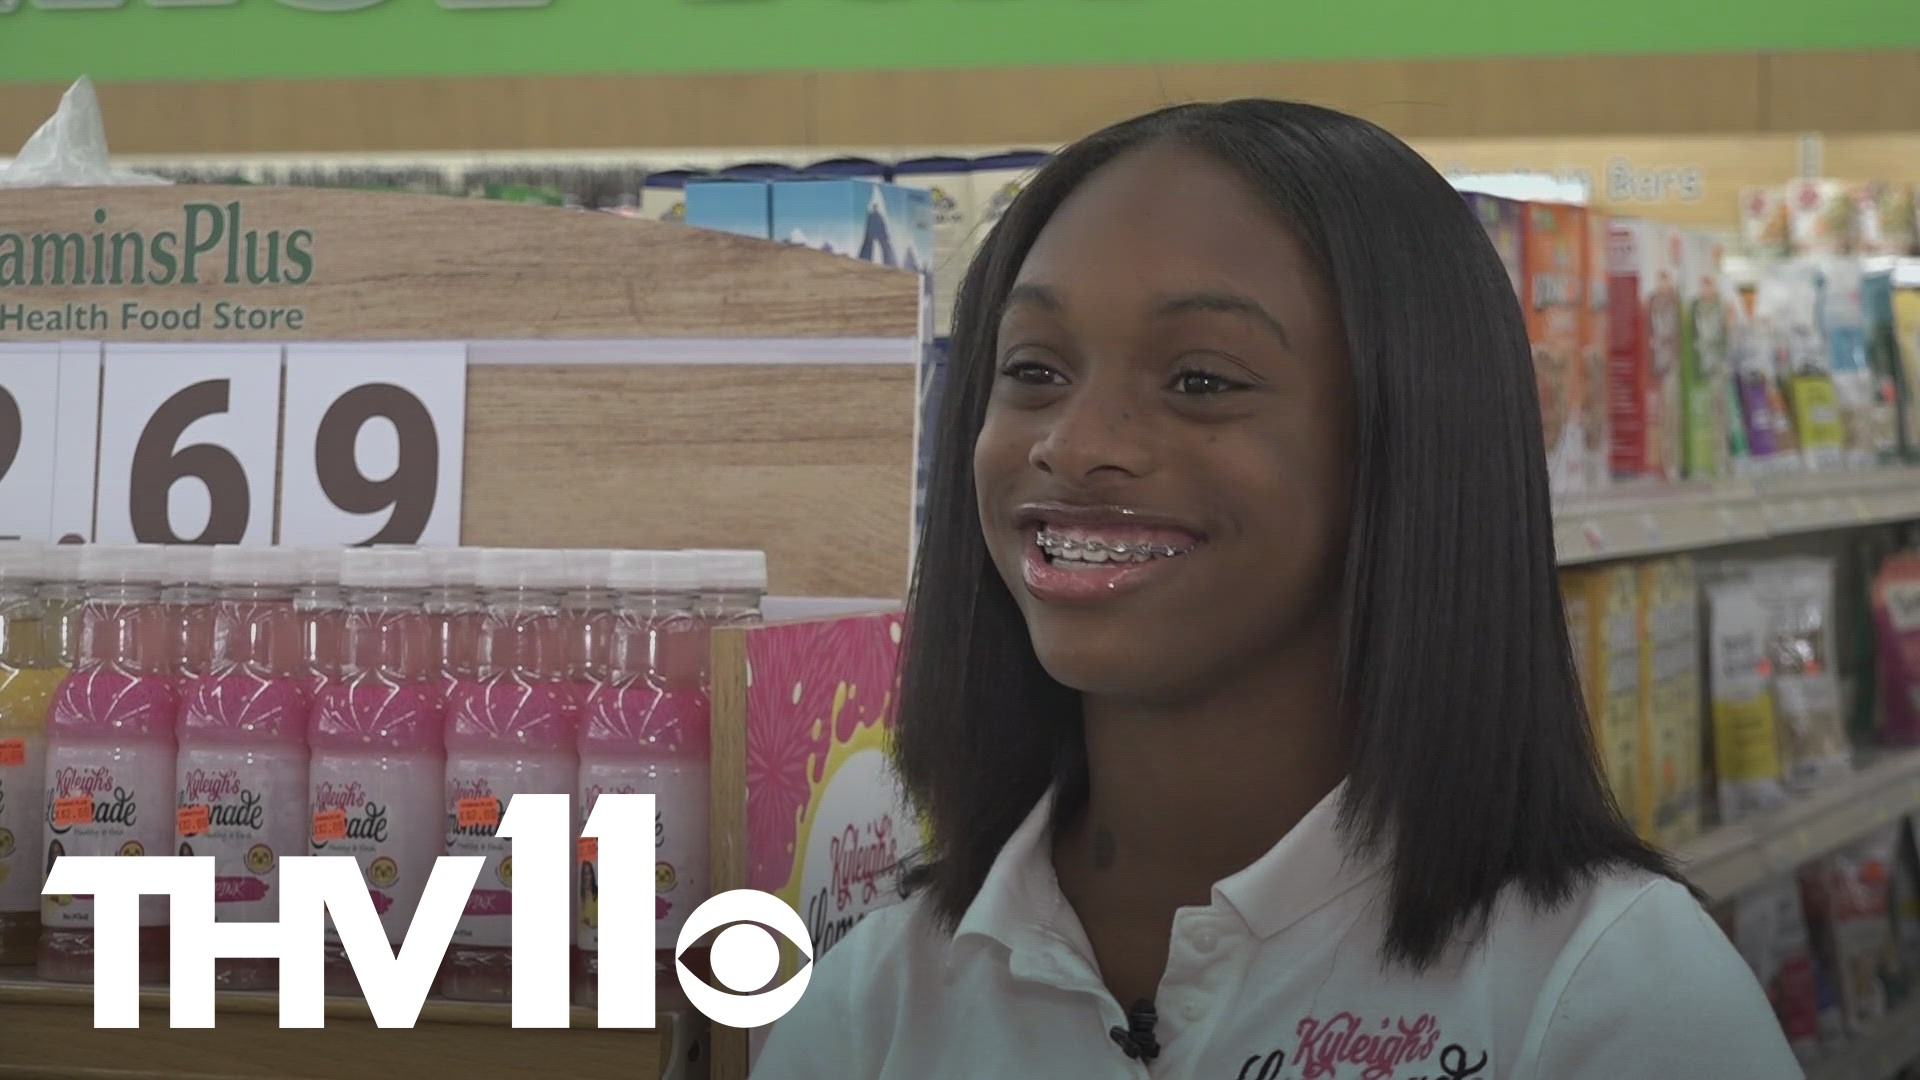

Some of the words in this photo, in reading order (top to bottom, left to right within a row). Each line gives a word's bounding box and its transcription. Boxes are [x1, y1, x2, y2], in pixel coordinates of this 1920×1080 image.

[0, 303, 108, 331] Health
[121, 303, 200, 331] Food
[213, 301, 304, 330] Store
[1292, 1011, 1441, 1080] Kyleigh's
